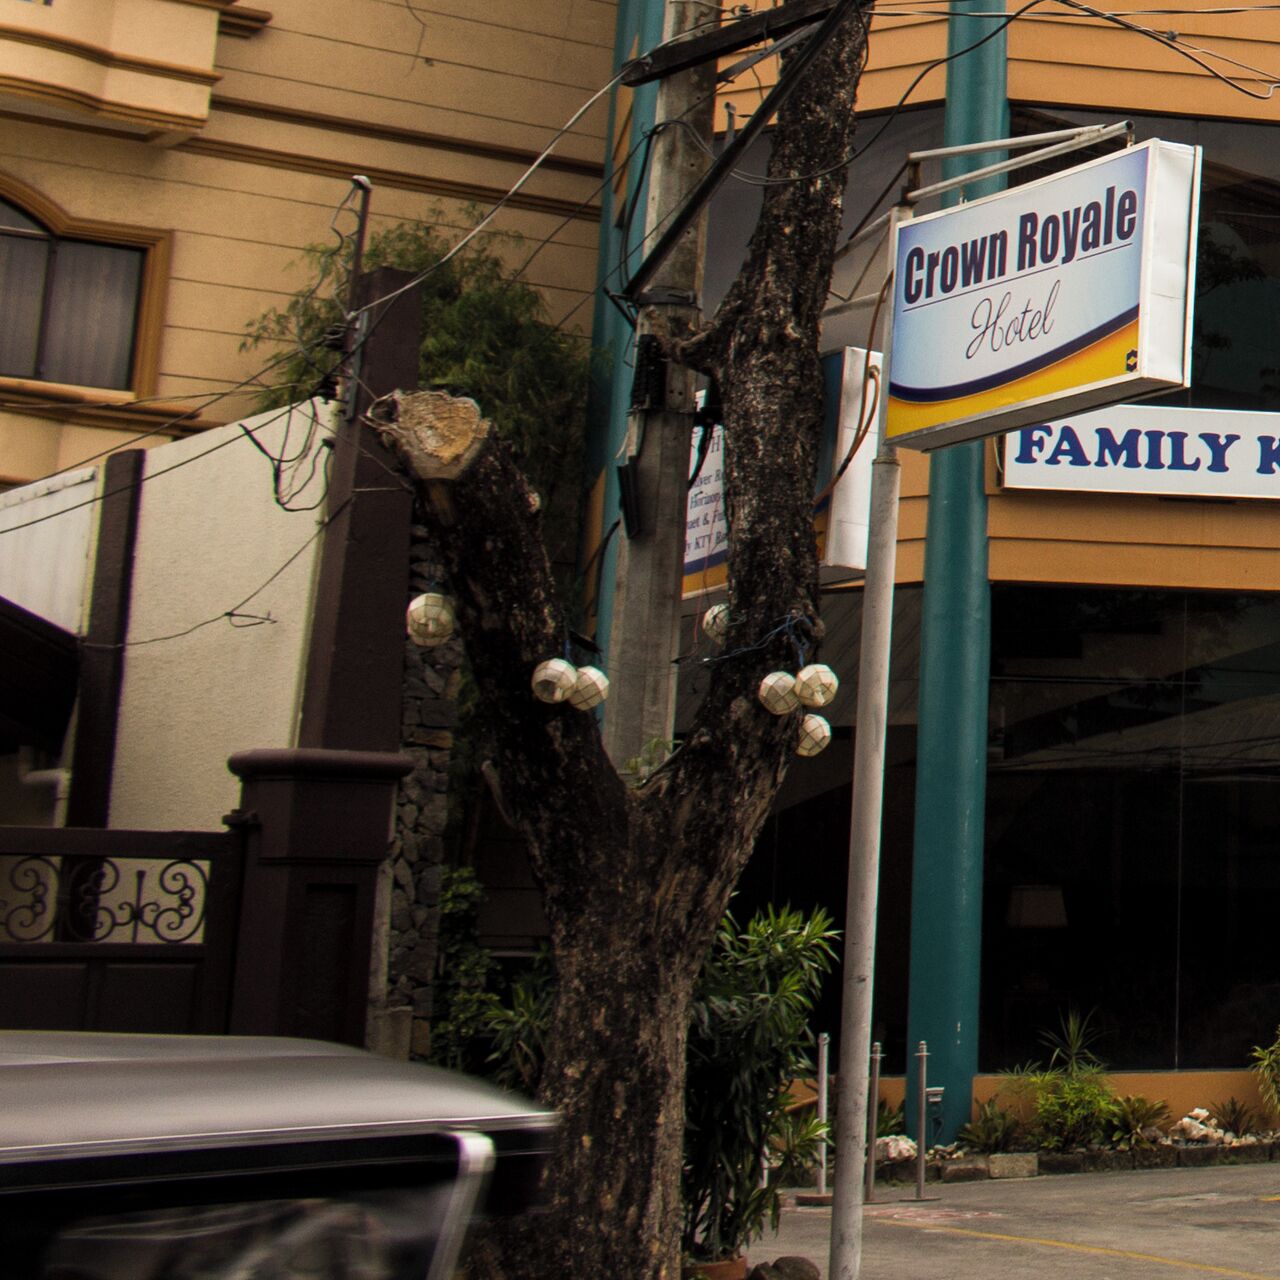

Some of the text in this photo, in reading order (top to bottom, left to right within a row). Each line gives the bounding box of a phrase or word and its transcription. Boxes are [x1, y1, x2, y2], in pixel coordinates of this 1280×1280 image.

[903, 185, 1138, 305] Crown Royale
[965, 280, 1062, 360] Hotel
[1014, 423, 1241, 474] FAMILY
